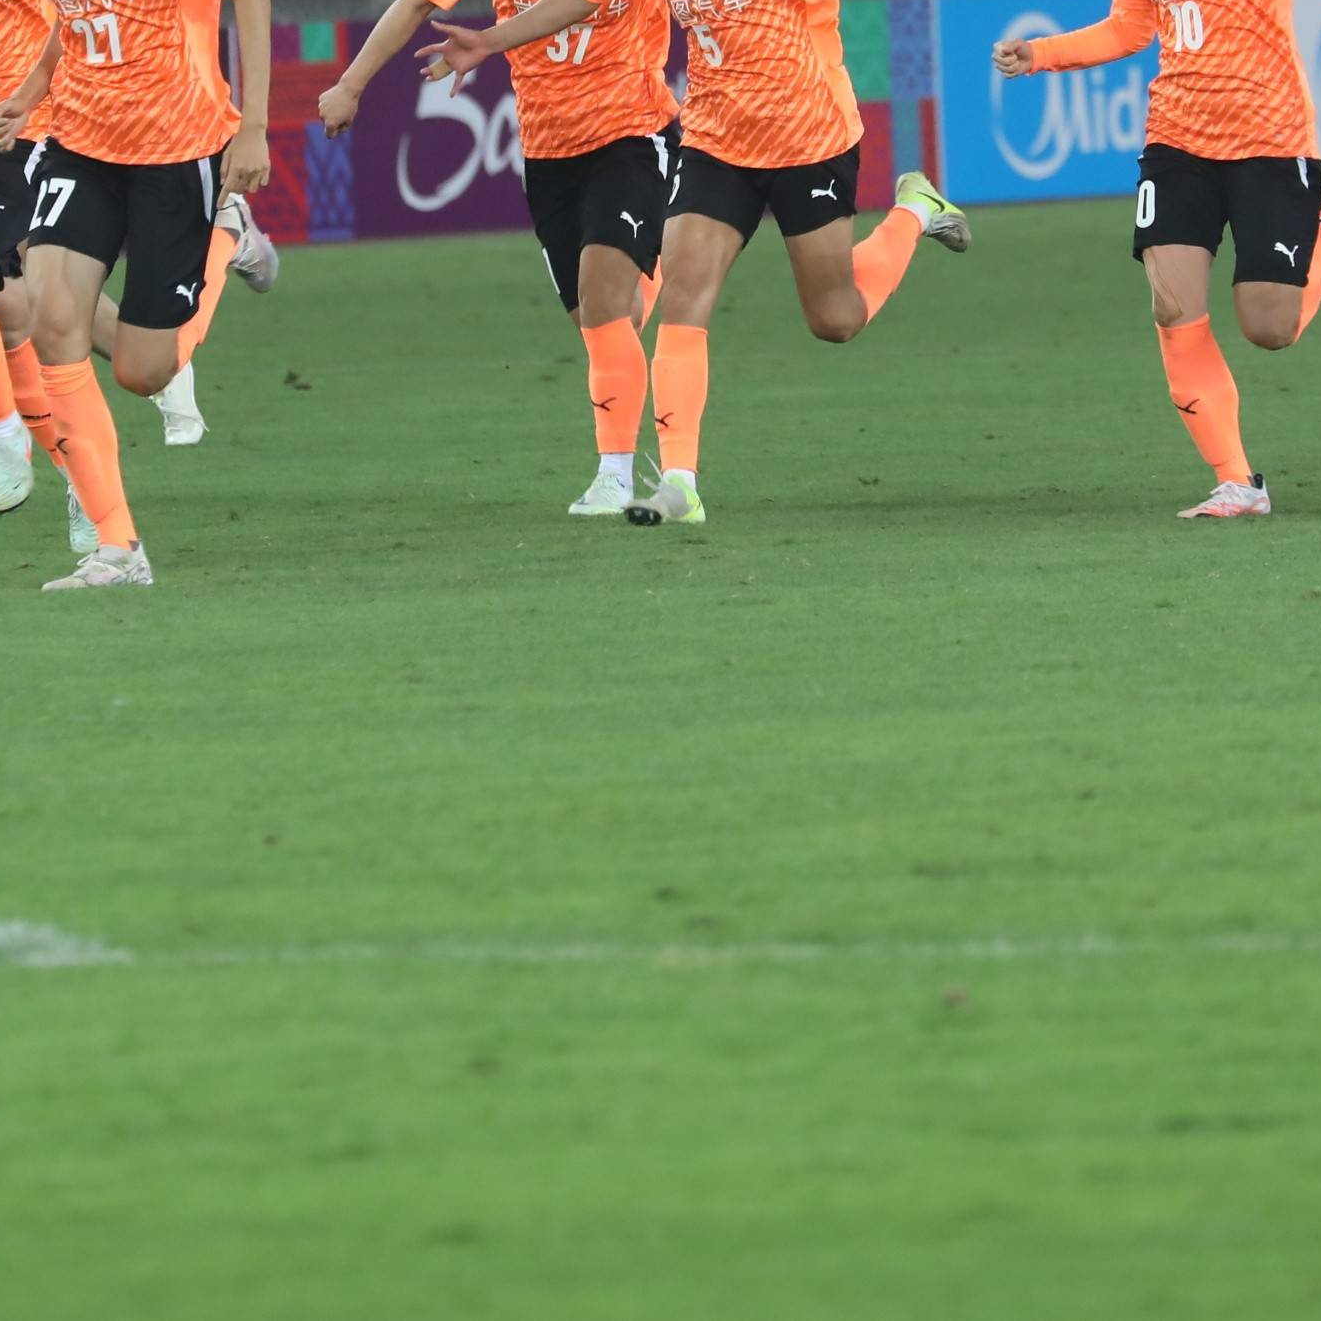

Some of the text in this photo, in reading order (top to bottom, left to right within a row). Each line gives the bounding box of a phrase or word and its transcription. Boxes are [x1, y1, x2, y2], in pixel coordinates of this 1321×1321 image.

[71, 13, 122, 64] 27
[546, 23, 594, 65] 37
[692, 24, 723, 67] 5
[1170, 0, 1204, 52] 10
